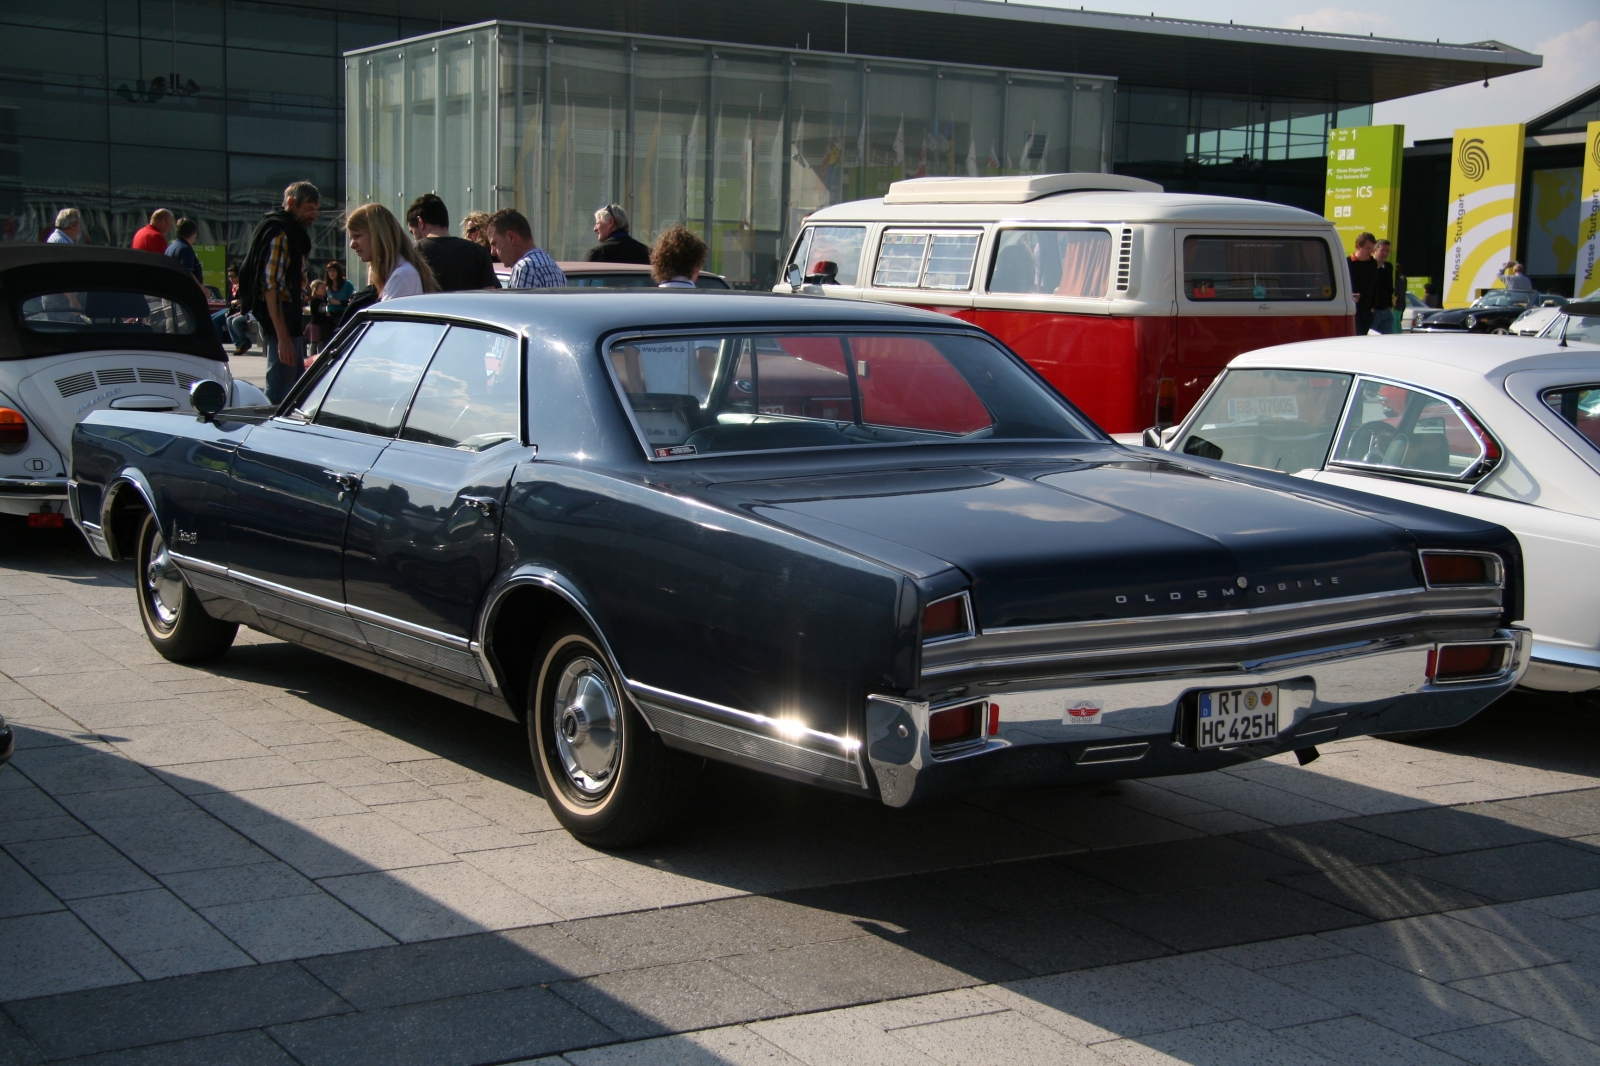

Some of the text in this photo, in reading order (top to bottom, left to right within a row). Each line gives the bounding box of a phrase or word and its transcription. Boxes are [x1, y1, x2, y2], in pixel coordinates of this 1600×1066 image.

[1352, 129, 1356, 140] 1
[1356, 185, 1373, 198] ICS
[1452, 192, 1466, 281] Messe Stuttgart
[1584, 188, 1600, 280] Messe Stuttgart
[33, 460, 44, 471] D
[1115, 576, 1339, 604] OLDSMOBILE
[1218, 690, 1242, 716] RT
[1202, 712, 1276, 745] HC 425H
